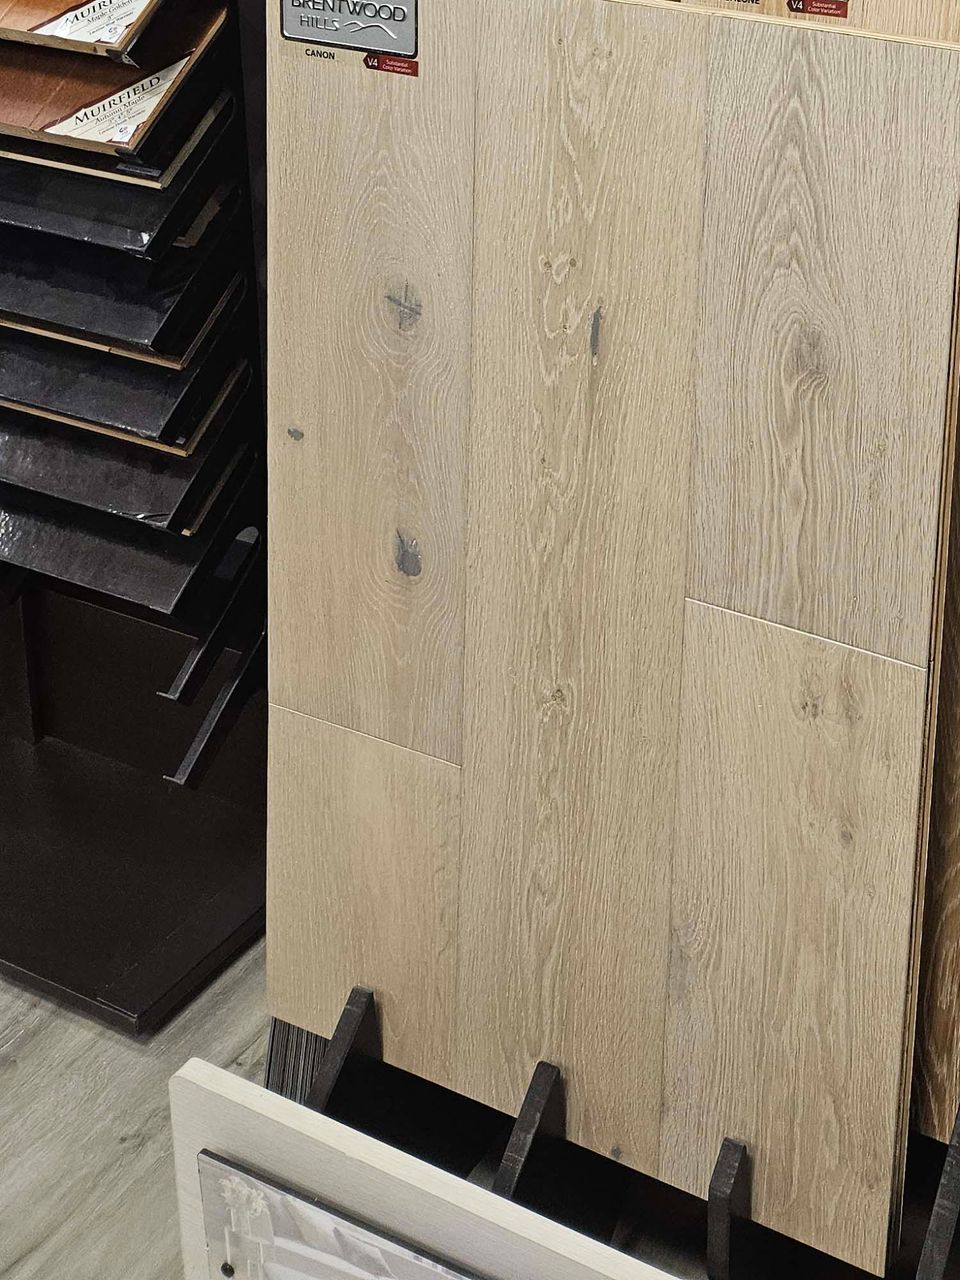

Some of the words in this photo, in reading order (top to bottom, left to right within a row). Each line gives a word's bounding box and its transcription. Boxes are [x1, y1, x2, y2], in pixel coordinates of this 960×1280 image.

[791, 0, 803, 10] V4
[86, 9, 107, 24] Maple
[300, 13, 340, 31] HILLS
[305, 48, 336, 60] CANON
[367, 57, 378, 67] V4
[73, 75, 161, 125] MUIRFIELD
[94, 107, 122, 124] Autumn
[123, 94, 145, 109] Maple
